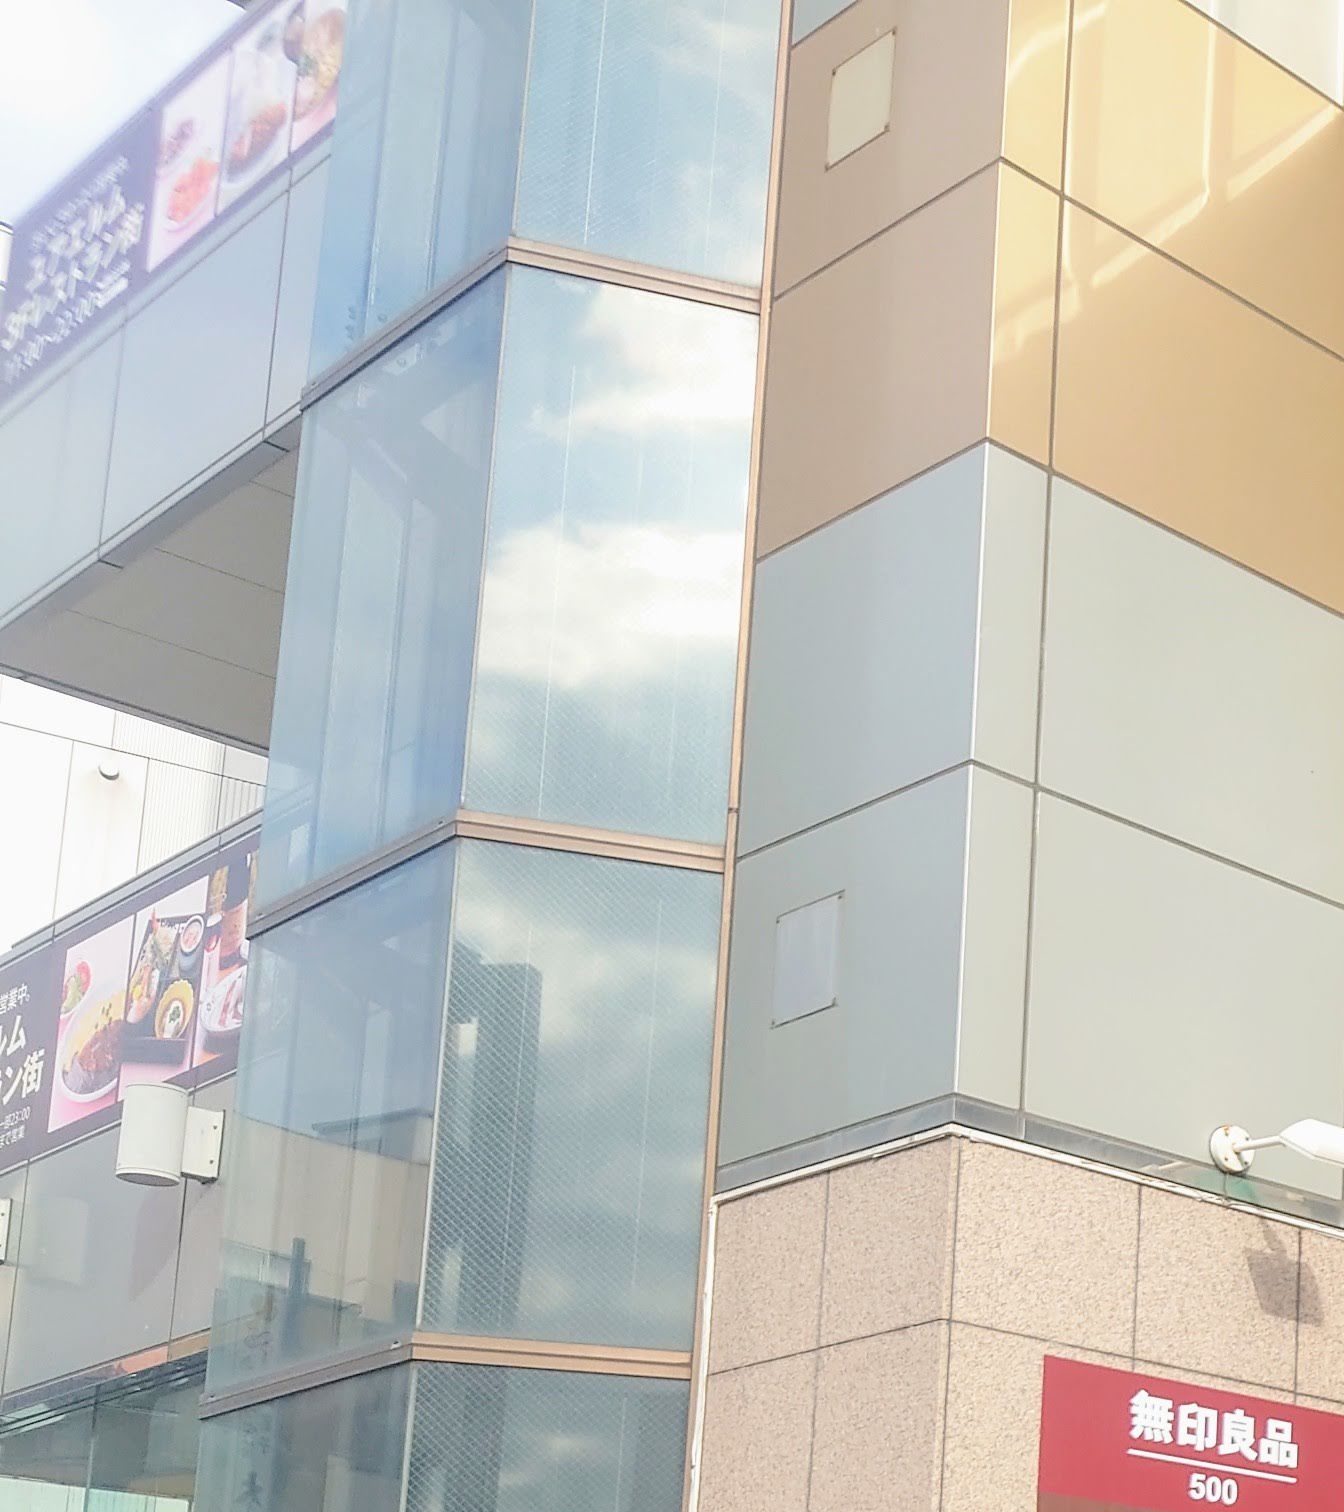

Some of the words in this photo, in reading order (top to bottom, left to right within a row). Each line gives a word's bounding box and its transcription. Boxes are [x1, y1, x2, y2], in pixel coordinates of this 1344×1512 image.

[0, 1049, 45, 1106] ン街
[1128, 1389, 1298, 1469] 無印良品
[1189, 1474, 1238, 1505] 500
